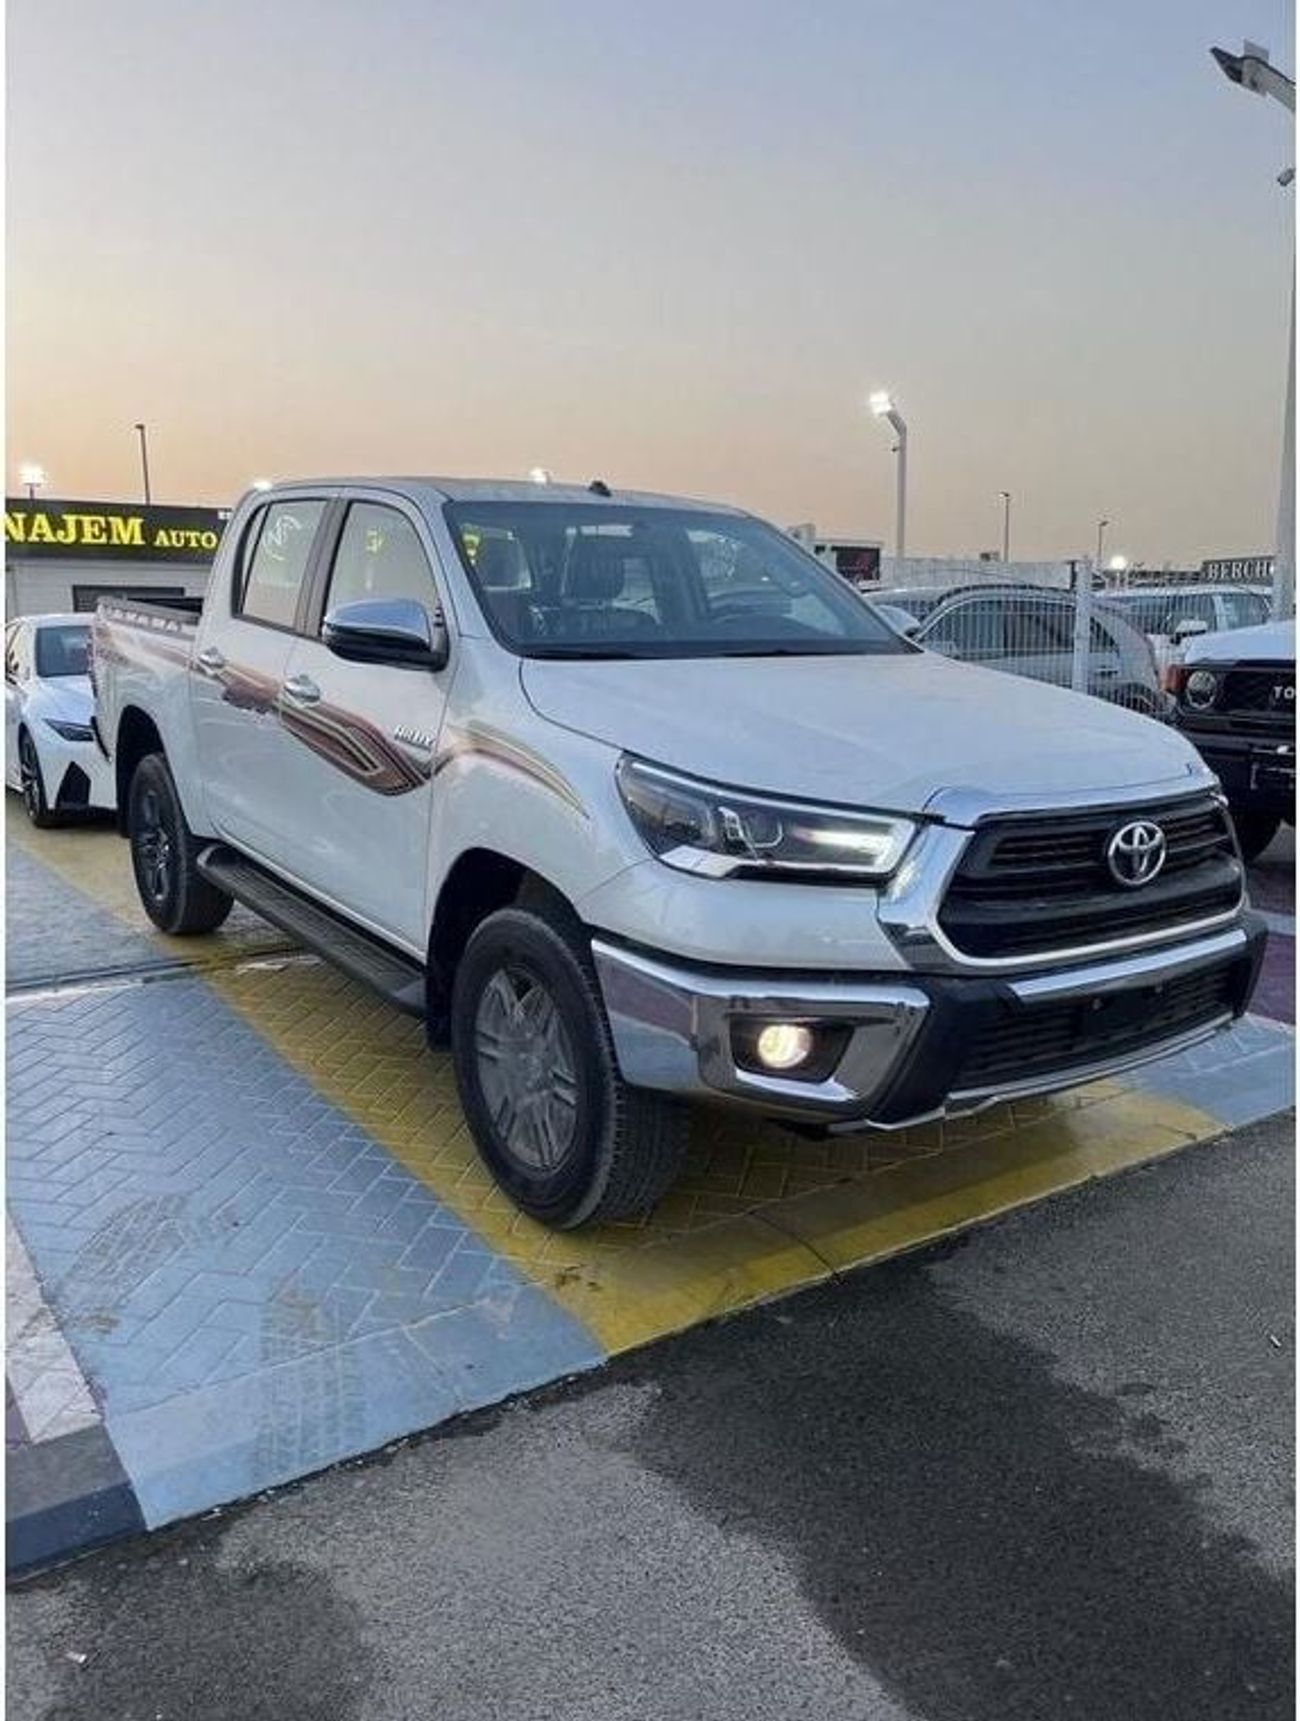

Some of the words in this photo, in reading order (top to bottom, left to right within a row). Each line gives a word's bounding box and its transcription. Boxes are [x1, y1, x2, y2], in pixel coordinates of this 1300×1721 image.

[6, 512, 145, 545] NAJEM
[154, 530, 218, 548] AUTO
[1273, 686, 1295, 700] TO
